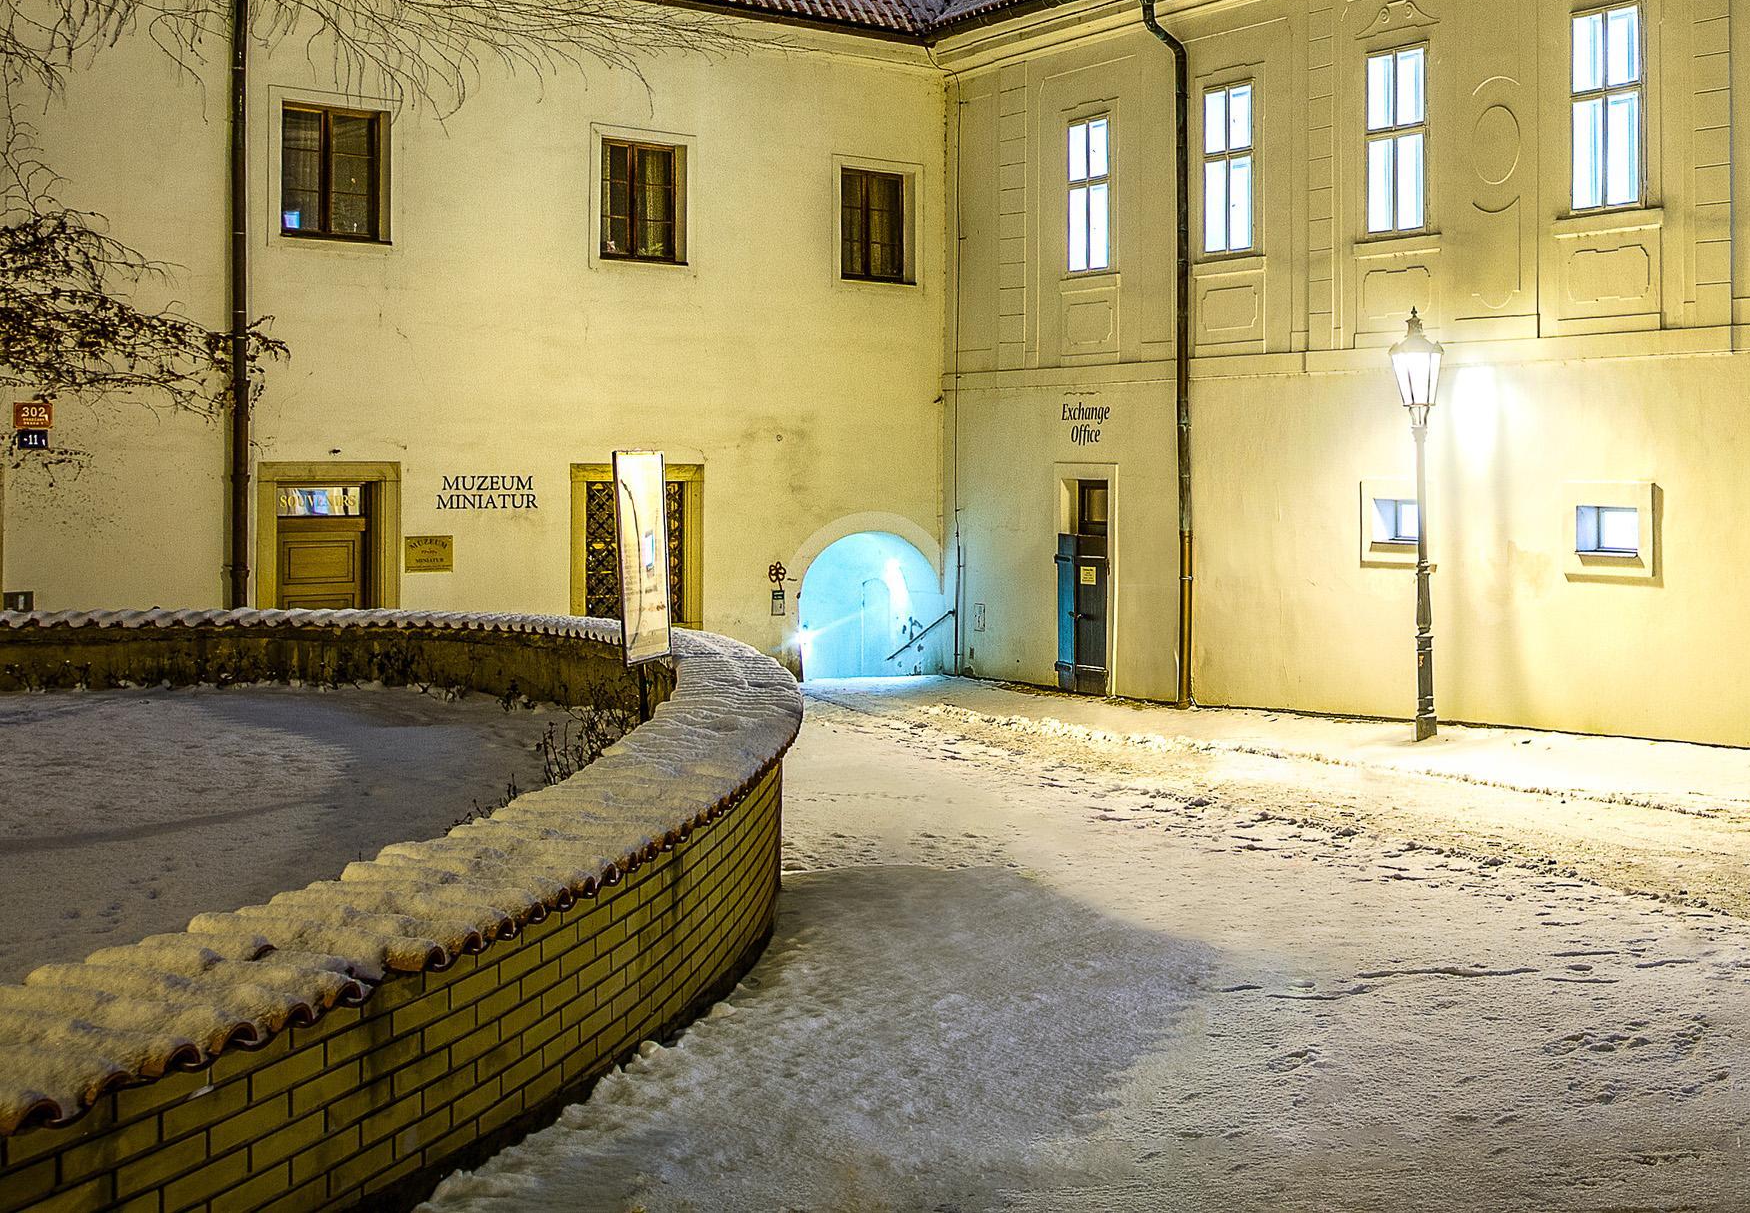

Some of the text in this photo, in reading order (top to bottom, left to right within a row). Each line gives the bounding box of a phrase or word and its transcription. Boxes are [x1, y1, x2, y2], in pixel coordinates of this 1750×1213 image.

[21, 406, 46, 417] 302
[1061, 401, 1110, 425] Exchange
[1071, 423, 1101, 446] Office
[441, 475, 533, 491] MUZEUM
[436, 493, 538, 510] MINIATUR
